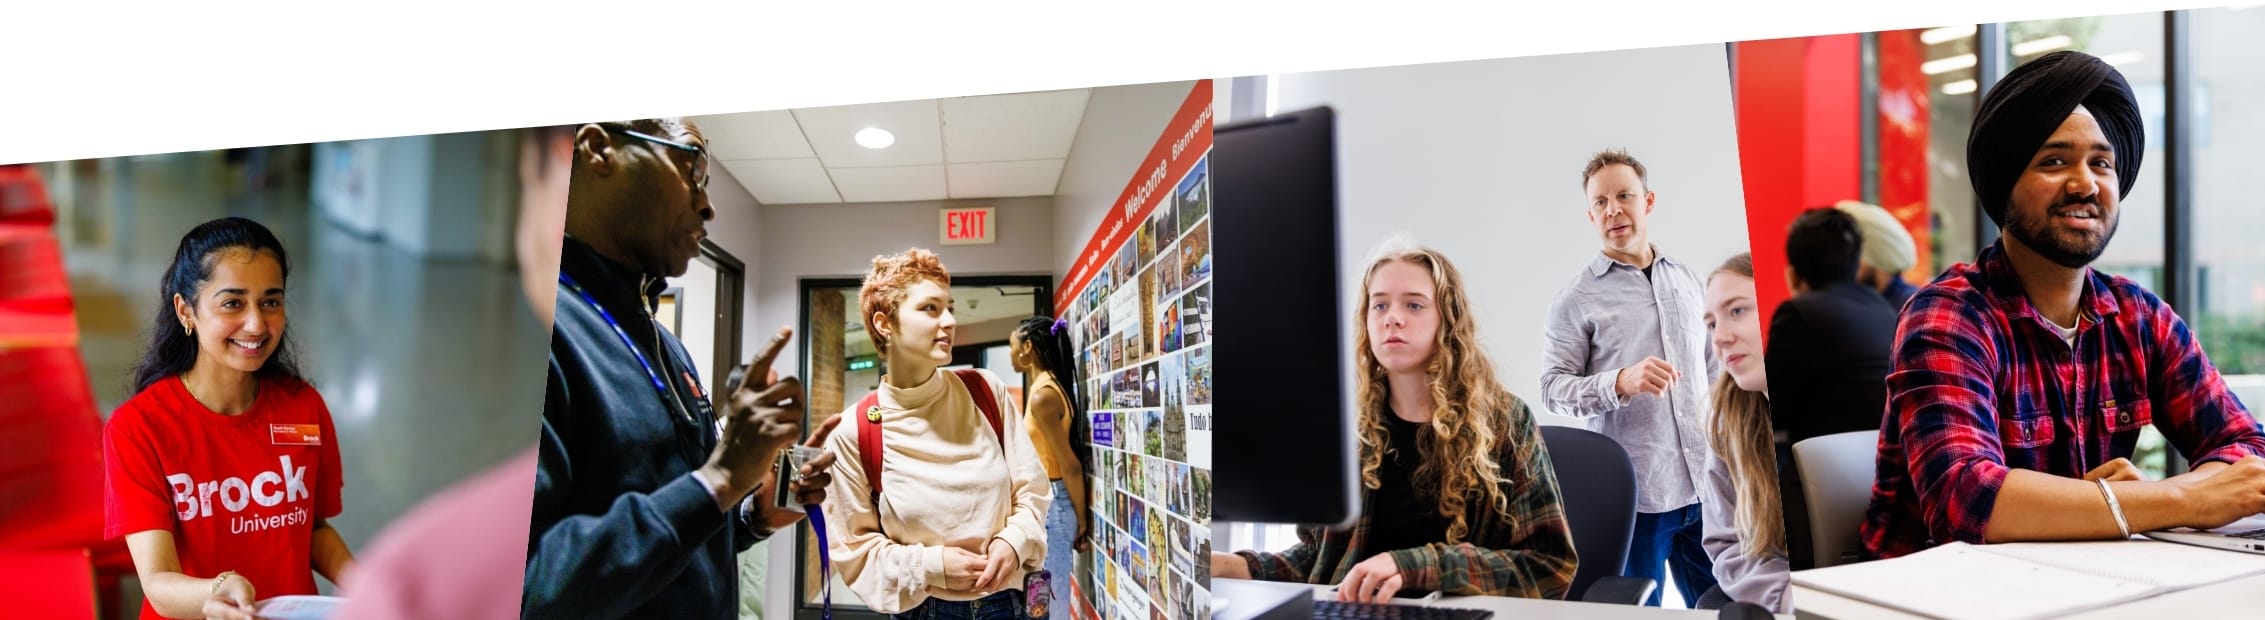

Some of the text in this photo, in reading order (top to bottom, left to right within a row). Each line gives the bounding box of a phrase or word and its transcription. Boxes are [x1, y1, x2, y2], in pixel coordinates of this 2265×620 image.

[1125, 158, 1167, 222] Welcome
[1172, 102, 1213, 162] Bienvenu
[947, 210, 987, 240] EXIT
[166, 454, 309, 522] Brock
[231, 506, 309, 534] University
